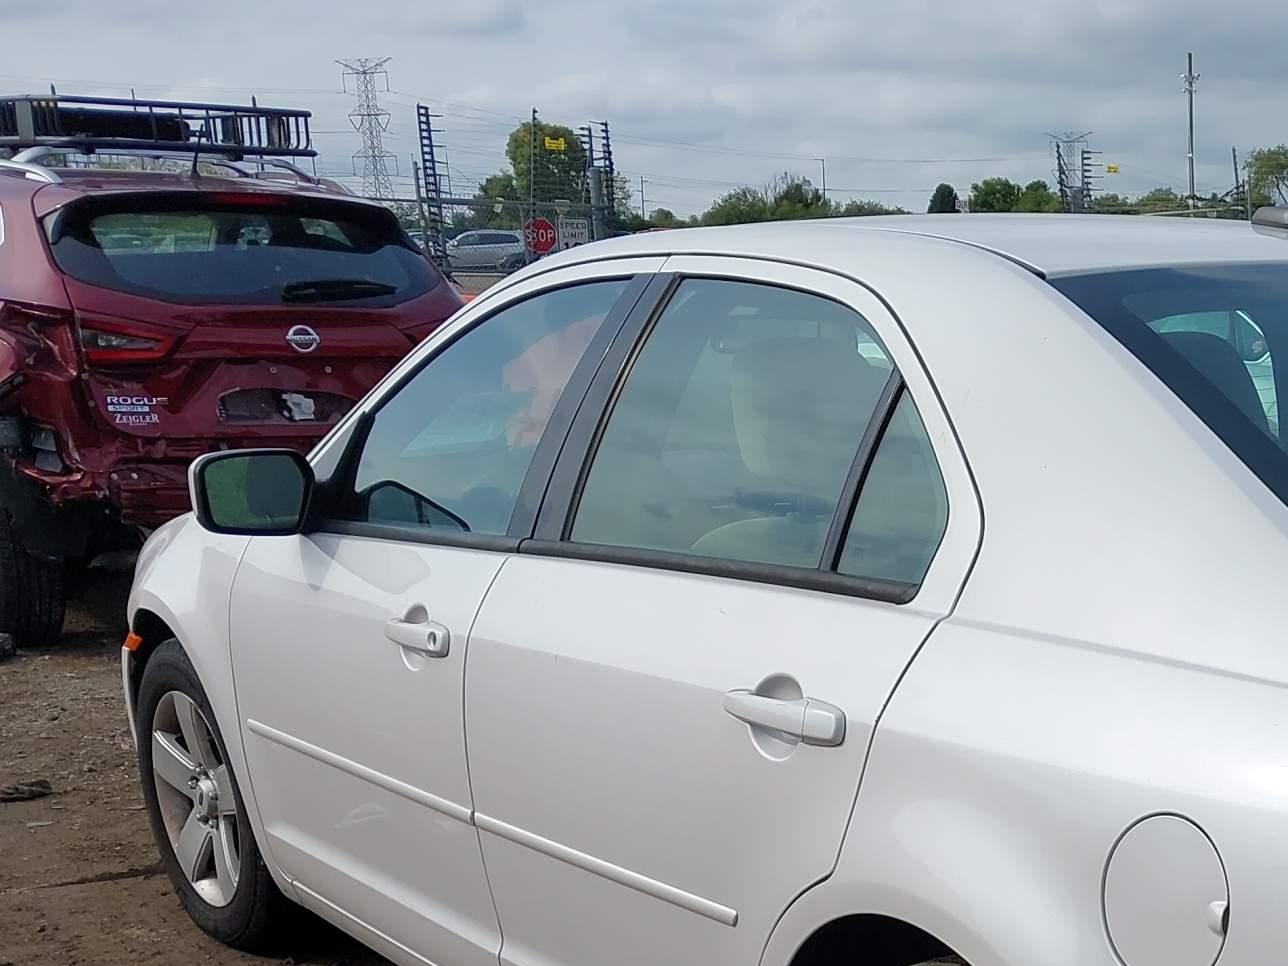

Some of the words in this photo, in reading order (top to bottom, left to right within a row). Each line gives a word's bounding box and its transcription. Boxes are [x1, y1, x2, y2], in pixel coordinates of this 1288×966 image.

[525, 229, 554, 242] STOP
[562, 231, 584, 239] LIMIT
[106, 396, 169, 405] ROGUE
[114, 413, 160, 424] ZEIGLER
